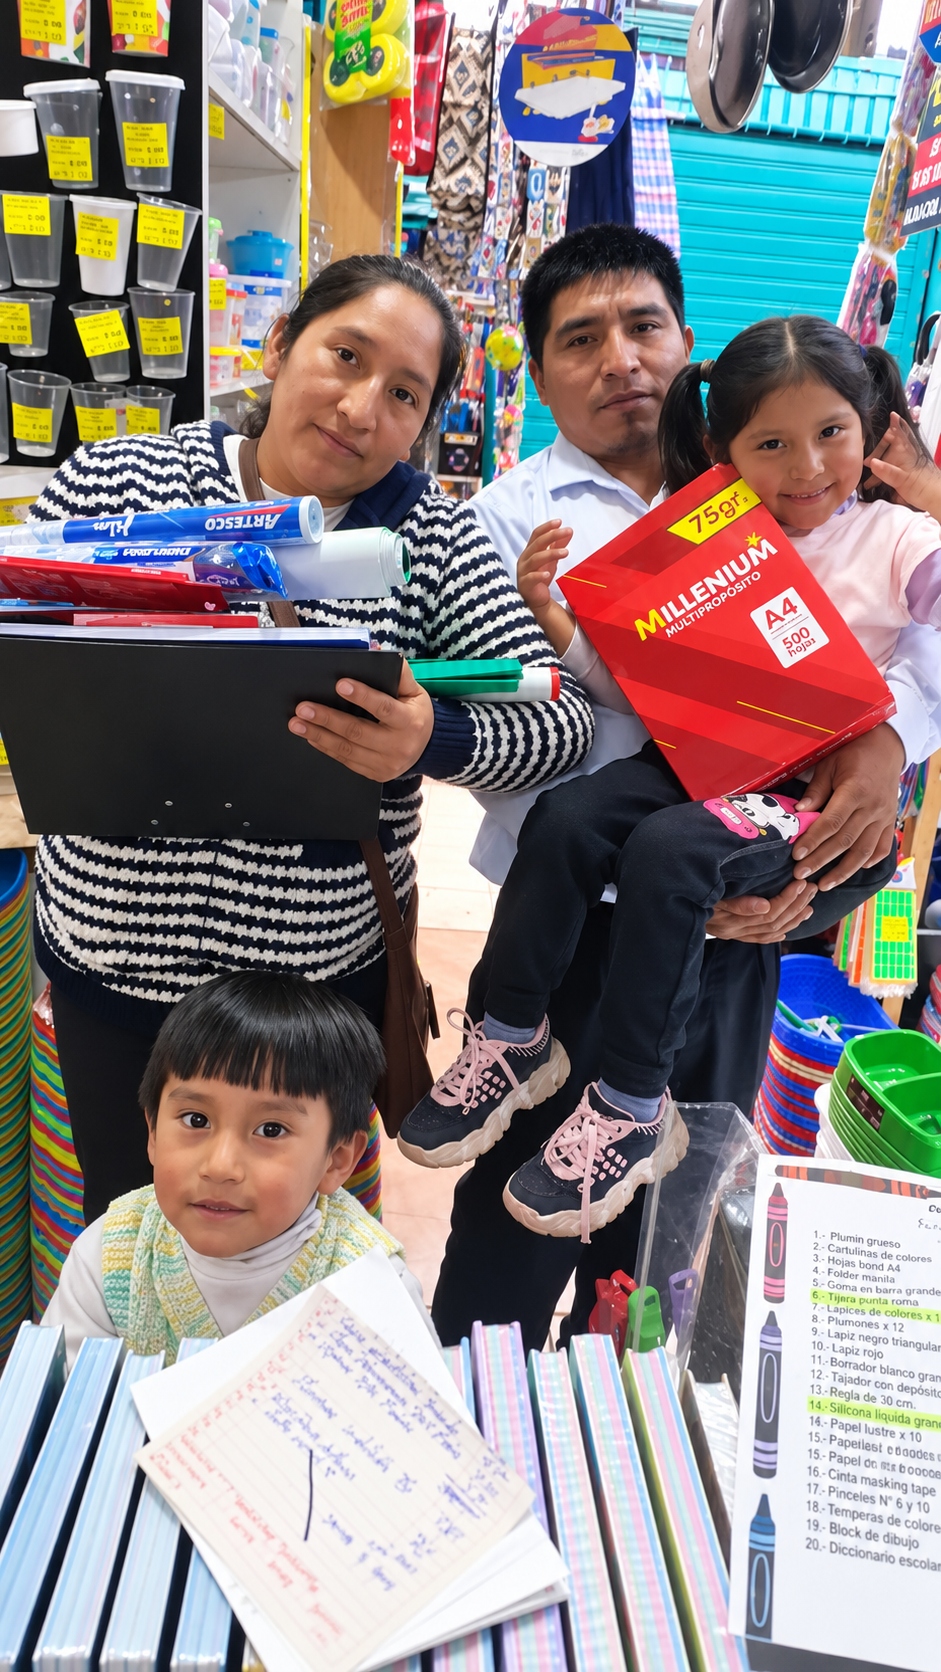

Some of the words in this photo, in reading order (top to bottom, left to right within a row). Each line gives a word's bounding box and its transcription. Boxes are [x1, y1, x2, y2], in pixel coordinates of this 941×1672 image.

[205, 514, 281, 530] ARTESCO
[634, 539, 778, 641] MILLENIUM
[666, 571, 761, 638] MULTIPROPÓSITO
[765, 597, 798, 630] A4
[782, 627, 810, 651] 500
[830, 1232, 864, 1244] Plumin
[867, 1238, 901, 1249] grueso
[828, 1244, 878, 1258] Cartulinas
[881, 1252, 893, 1261] de
[896, 1254, 932, 1263] colores
[828, 1256, 856, 1270] Hojas
[859, 1259, 884, 1271] bond
[887, 1263, 901, 1272] A4
[828, 1268, 859, 1280] Folder
[827, 1280, 857, 1292] Goma
[860, 1285, 872, 1294] en
[876, 1285, 902, 1295] barra
[906, 1288, 941, 1297] grande
[828, 1292, 856, 1304] Tijera
[859, 1296, 888, 1306] punta
[891, 1298, 919, 1306] roma
[869, 1307, 881, 1317] de
[885, 1309, 922, 1320] colores
[828, 1316, 879, 1330] Plumones
[883, 1322, 889, 1330] x
[893, 1322, 904, 1333] 12
[828, 1328, 855, 1341] Lapiz
[859, 1334, 888, 1346] negro
[832, 1342, 860, 1357] Lapiz
[863, 1348, 884, 1359] rojo
[830, 1357, 877, 1373] Borrador
[880, 1362, 914, 1379] blanco
[832, 1372, 871, 1389] Tajador
[874, 1380, 893, 1391] con
[830, 1387, 860, 1404] Regla
[863, 1391, 877, 1402] de
[881, 1394, 893, 1406] 30
[896, 1399, 916, 1409] cm.
[830, 1402, 872, 1419] Silicona
[831, 1419, 861, 1434] Papel
[865, 1423, 896, 1438] lustre
[899, 1430, 905, 1439] x
[909, 1432, 922, 1443] 10
[829, 1452, 860, 1468] Papel
[828, 1469, 857, 1484] Cinta
[861, 1476, 908, 1494] masking
[911, 1484, 936, 1497] tape
[828, 1486, 876, 1504] Pinceles
[896, 1499, 903, 1509] 6
[906, 1502, 913, 1513] y
[918, 1502, 930, 1514] 10
[828, 1504, 884, 1523] Temperas
[888, 1515, 901, 1527] de
[829, 1522, 861, 1540] Block
[865, 1528, 879, 1541] de
[883, 1532, 919, 1550] dibujo
[829, 1541, 896, 1564] Diccionario
